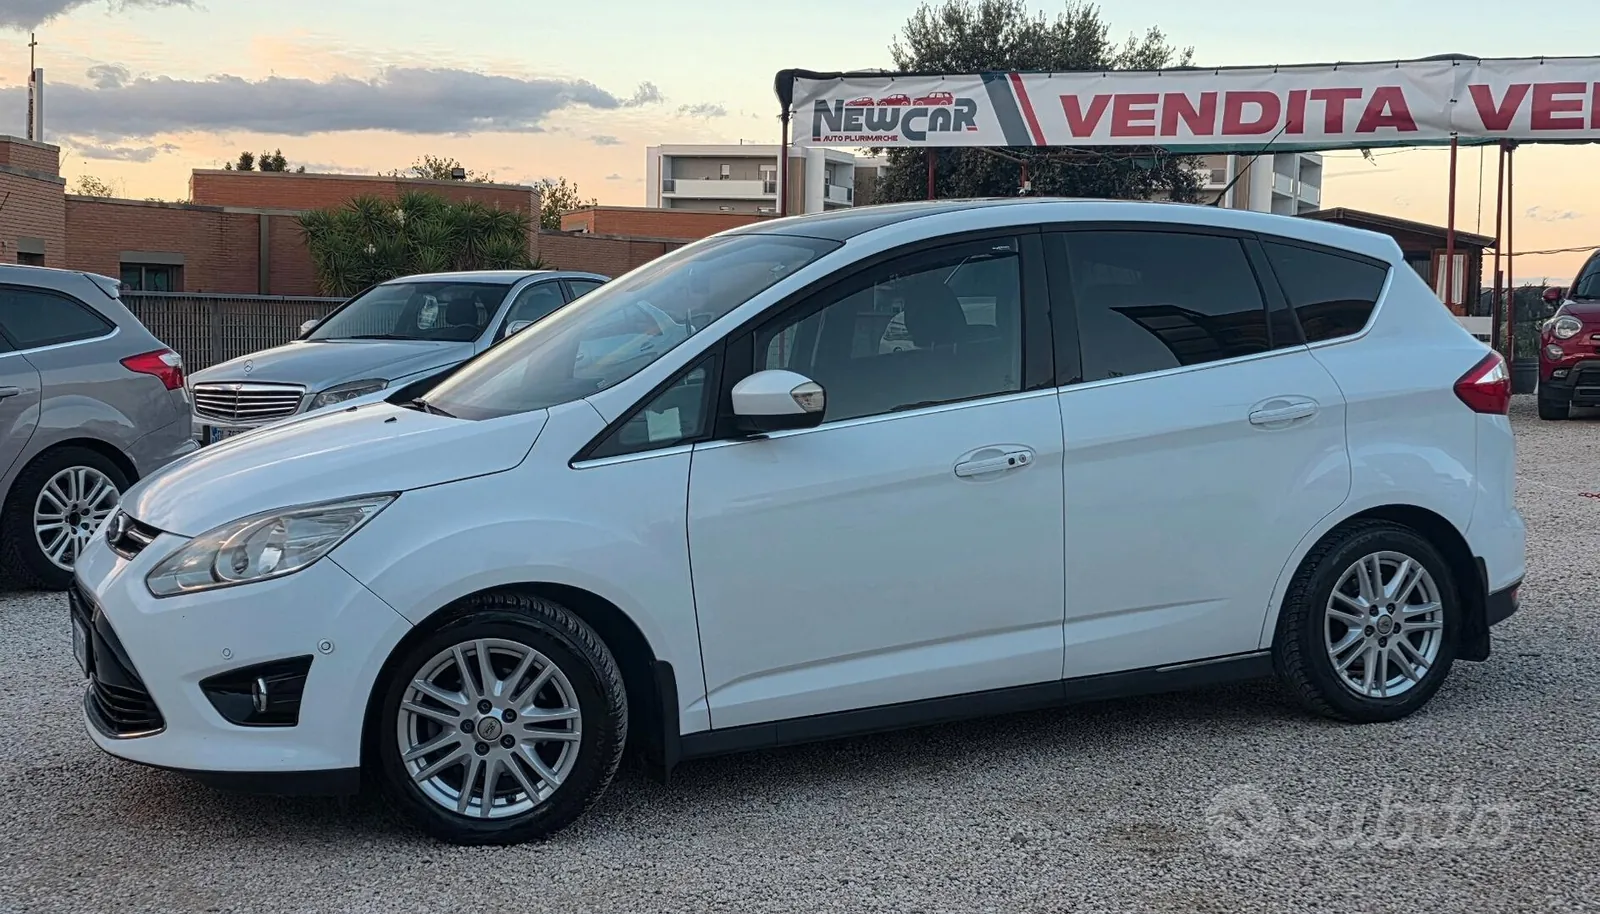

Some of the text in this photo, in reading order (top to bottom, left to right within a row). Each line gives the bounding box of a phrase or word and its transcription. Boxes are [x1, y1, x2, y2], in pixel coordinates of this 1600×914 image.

[1059, 86, 1418, 137] VENDITA
[1467, 82, 1600, 131] VE
[823, 134, 899, 142] AUTO PLURIMARCHE
